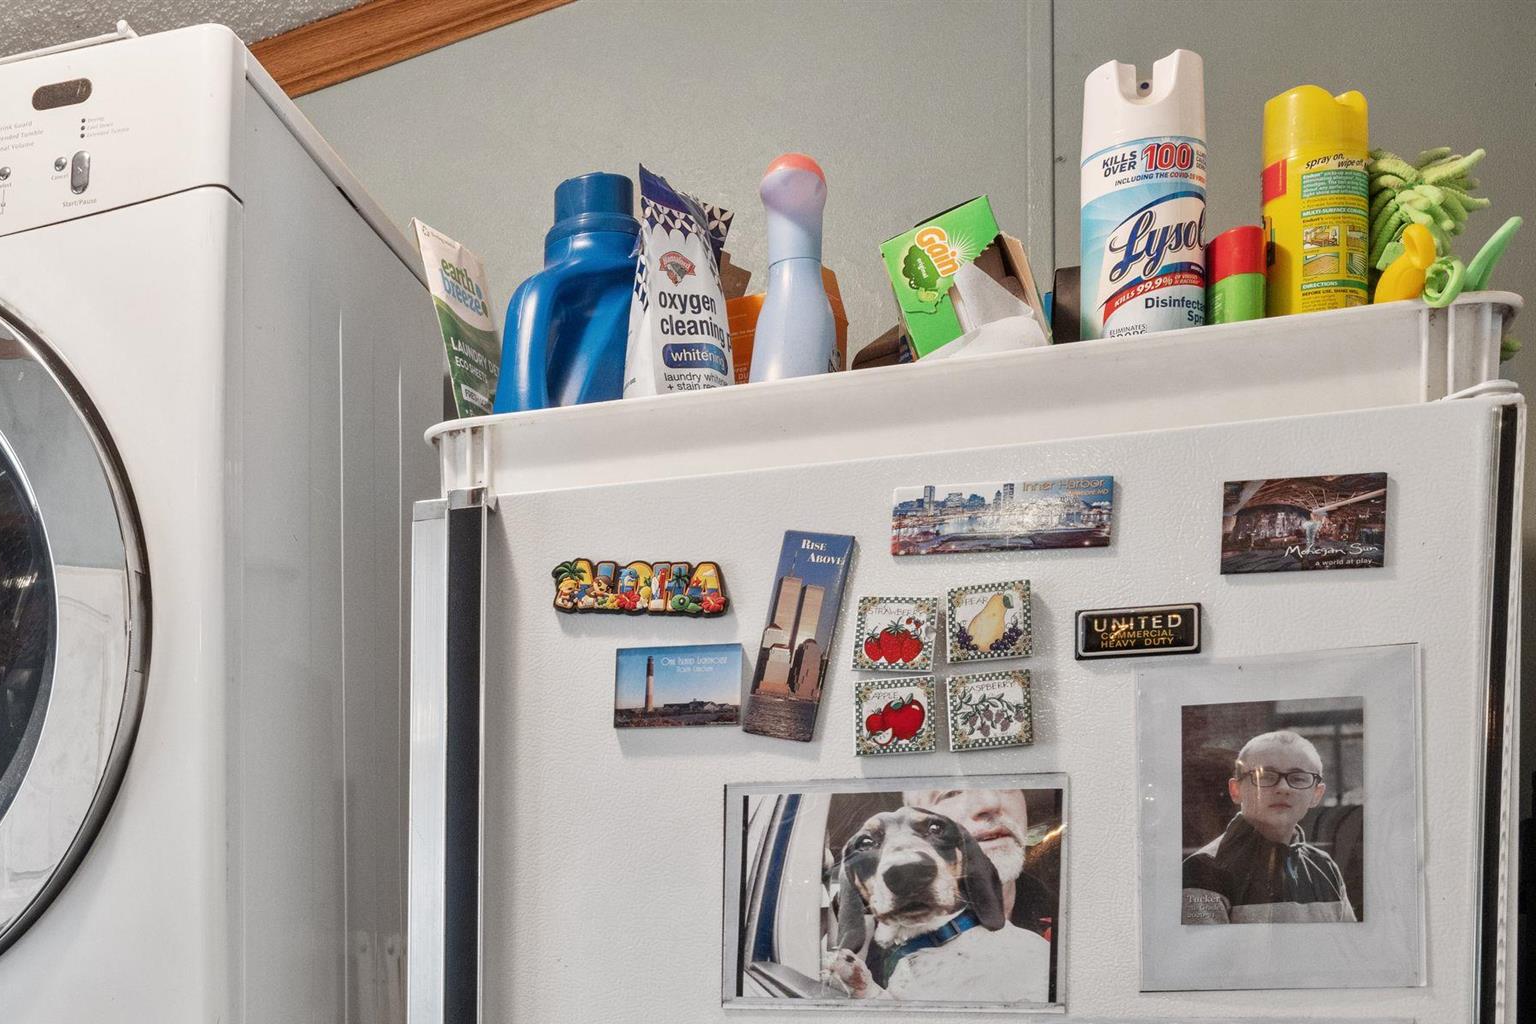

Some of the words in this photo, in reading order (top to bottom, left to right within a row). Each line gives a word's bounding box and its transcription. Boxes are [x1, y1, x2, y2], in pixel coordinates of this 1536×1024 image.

[1102, 150, 1137, 169] KILLS
[1140, 142, 1194, 172] 100
[1305, 155, 1332, 170] spray
[1104, 160, 1137, 178] OVER
[1114, 173, 1154, 187] INCLUDING
[1155, 171, 1169, 179] THE
[62, 198, 98, 208] Start/Pause
[915, 227, 961, 278] Gain
[1109, 210, 1205, 282] Lysol
[441, 258, 476, 296] earth
[1302, 281, 1338, 290] DIRECTIONS
[439, 267, 483, 316] breeze
[1113, 291, 1135, 308] KILLS
[1136, 277, 1173, 295] 99.9%
[658, 291, 717, 315] oxygen
[660, 315, 726, 348] cleaning
[664, 372, 702, 385] laundry
[1023, 480, 1055, 492] Inner
[1349, 542, 1379, 555] Sun
[554, 559, 729, 618] ALOHA
[1093, 613, 1182, 633] UNITED
[1100, 629, 1175, 640] COMMERCIAL
[1100, 639, 1137, 649] HEAVY
[1144, 637, 1175, 647] DUTY
[872, 691, 897, 700] APPLE
[1186, 894, 1221, 903] Tucker
